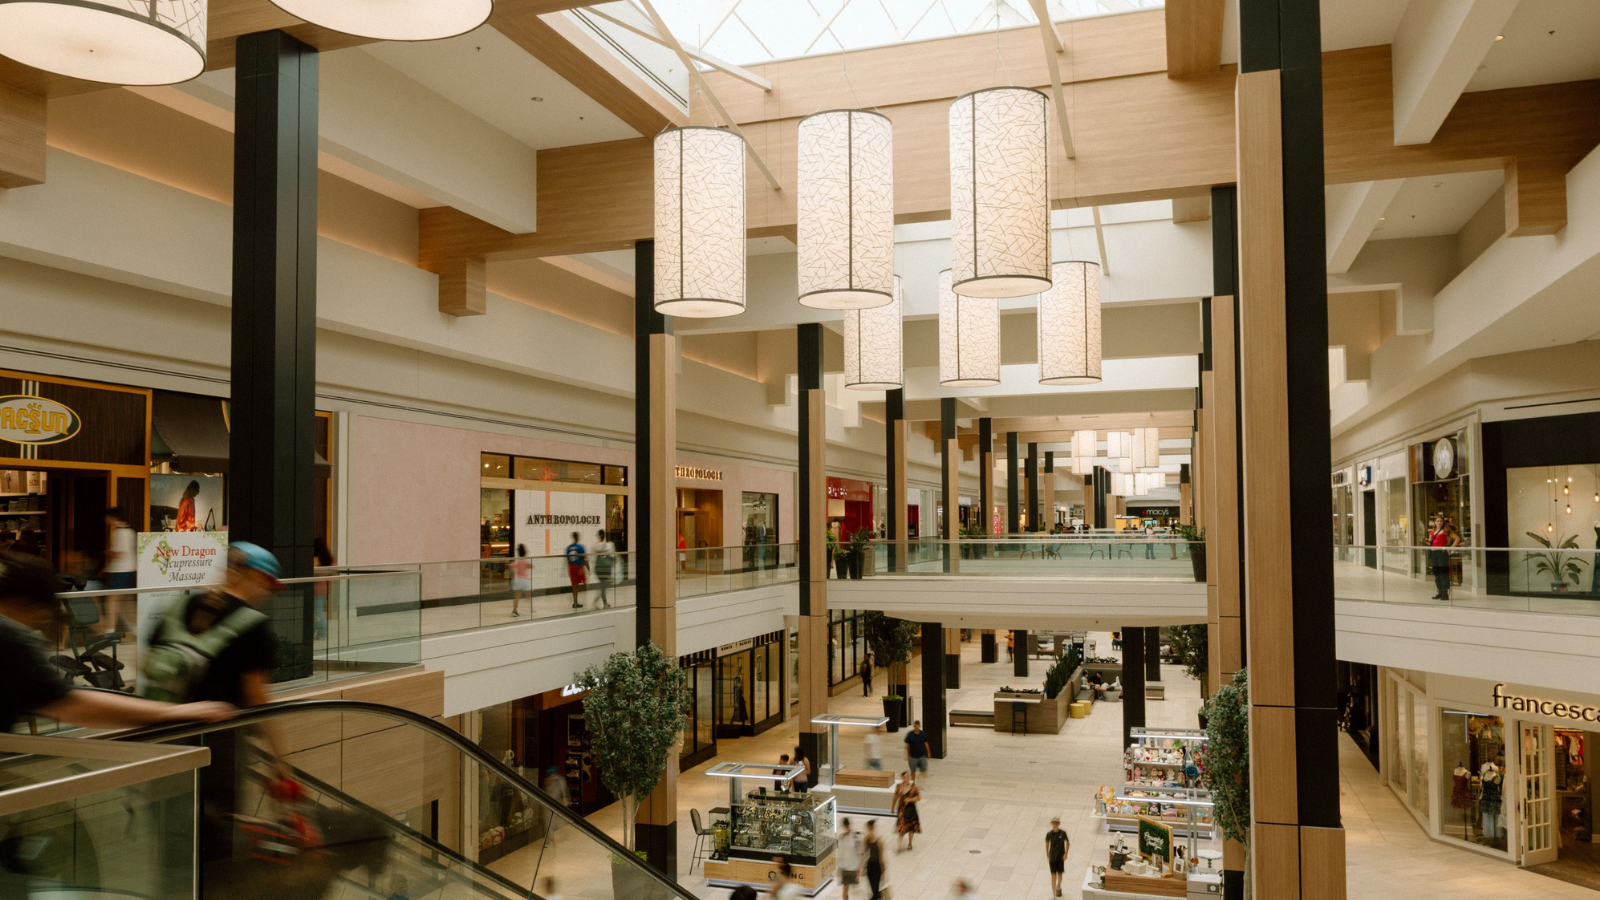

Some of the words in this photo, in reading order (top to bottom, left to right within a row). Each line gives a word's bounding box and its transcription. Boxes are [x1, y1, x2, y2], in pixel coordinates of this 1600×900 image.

[675, 466, 723, 481] THROPOLOGIE
[526, 514, 601, 525] ANTHROPOLOGIE
[156, 545, 179, 558] New
[182, 545, 217, 559] Dragon
[160, 558, 213, 572] Acupressure
[168, 571, 206, 583] Massage
